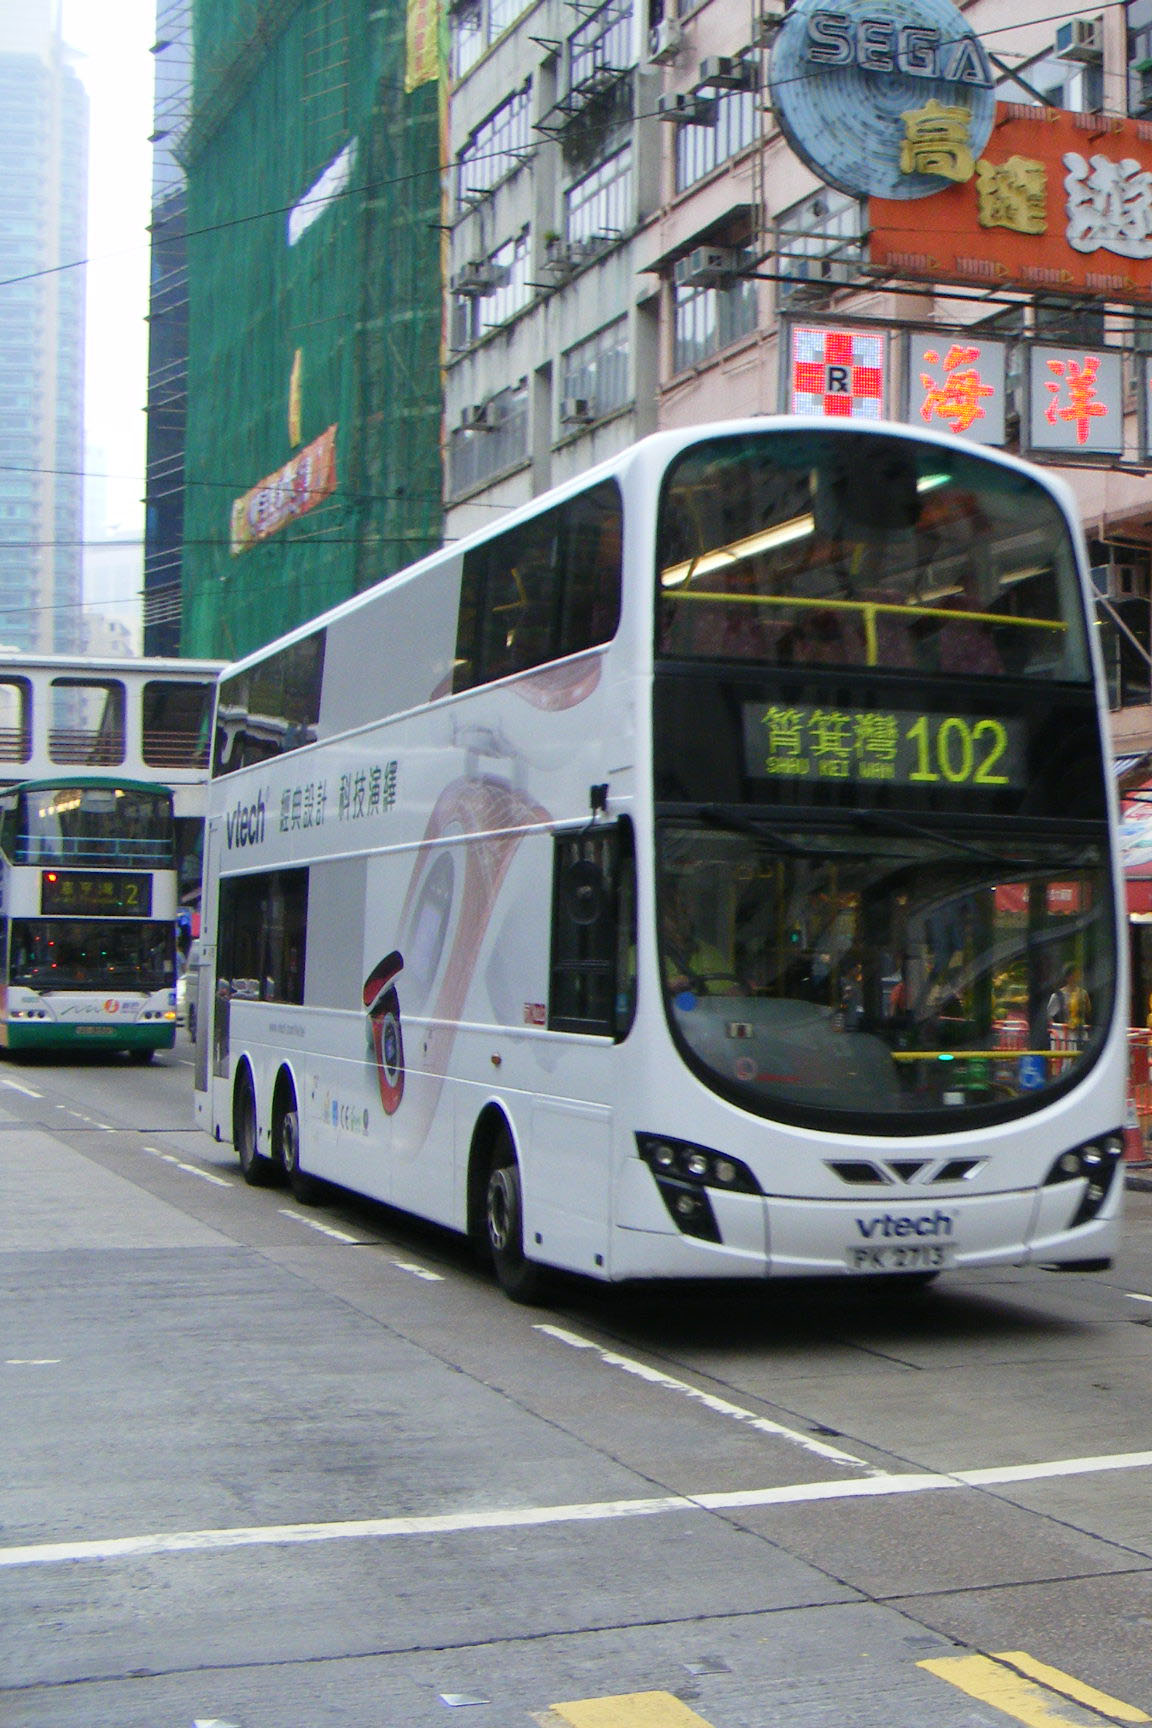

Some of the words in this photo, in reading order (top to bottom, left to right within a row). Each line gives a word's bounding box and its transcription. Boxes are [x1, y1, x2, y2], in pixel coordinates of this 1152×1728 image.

[807, 9, 995, 89] SEGA
[762, 706, 899, 760] 筲箕灣
[905, 716, 1010, 784] 102
[226, 784, 266, 849] vtech
[125, 884, 139, 905] 2
[855, 1210, 953, 1238] vtech
